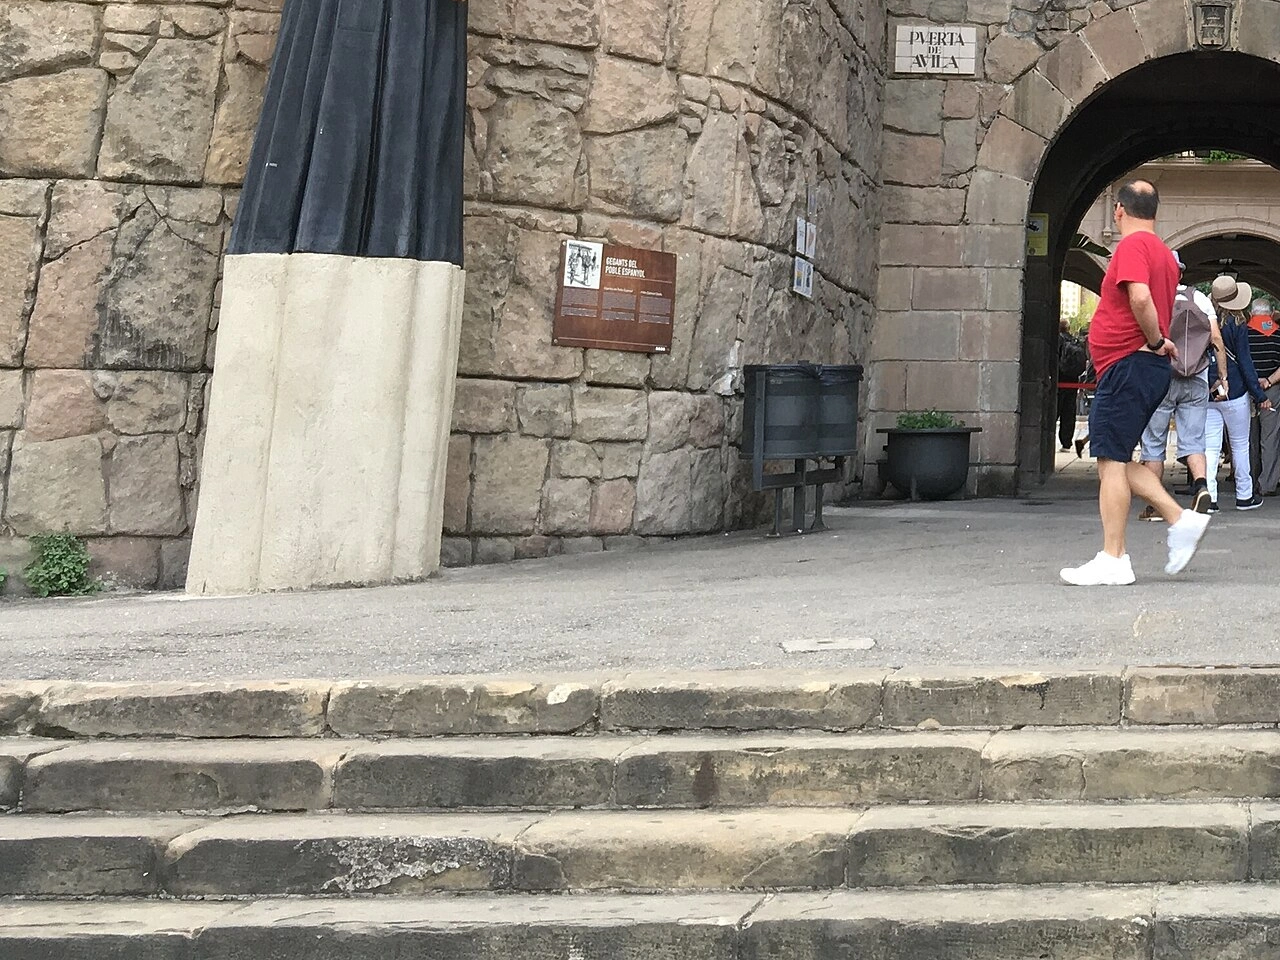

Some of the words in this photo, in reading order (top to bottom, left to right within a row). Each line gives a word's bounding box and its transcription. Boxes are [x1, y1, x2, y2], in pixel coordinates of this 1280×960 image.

[912, 55, 958, 68] AVILA
[629, 259, 637, 268] DEL
[605, 265, 621, 275] POBLE
[622, 267, 645, 278] ESPANYOL
